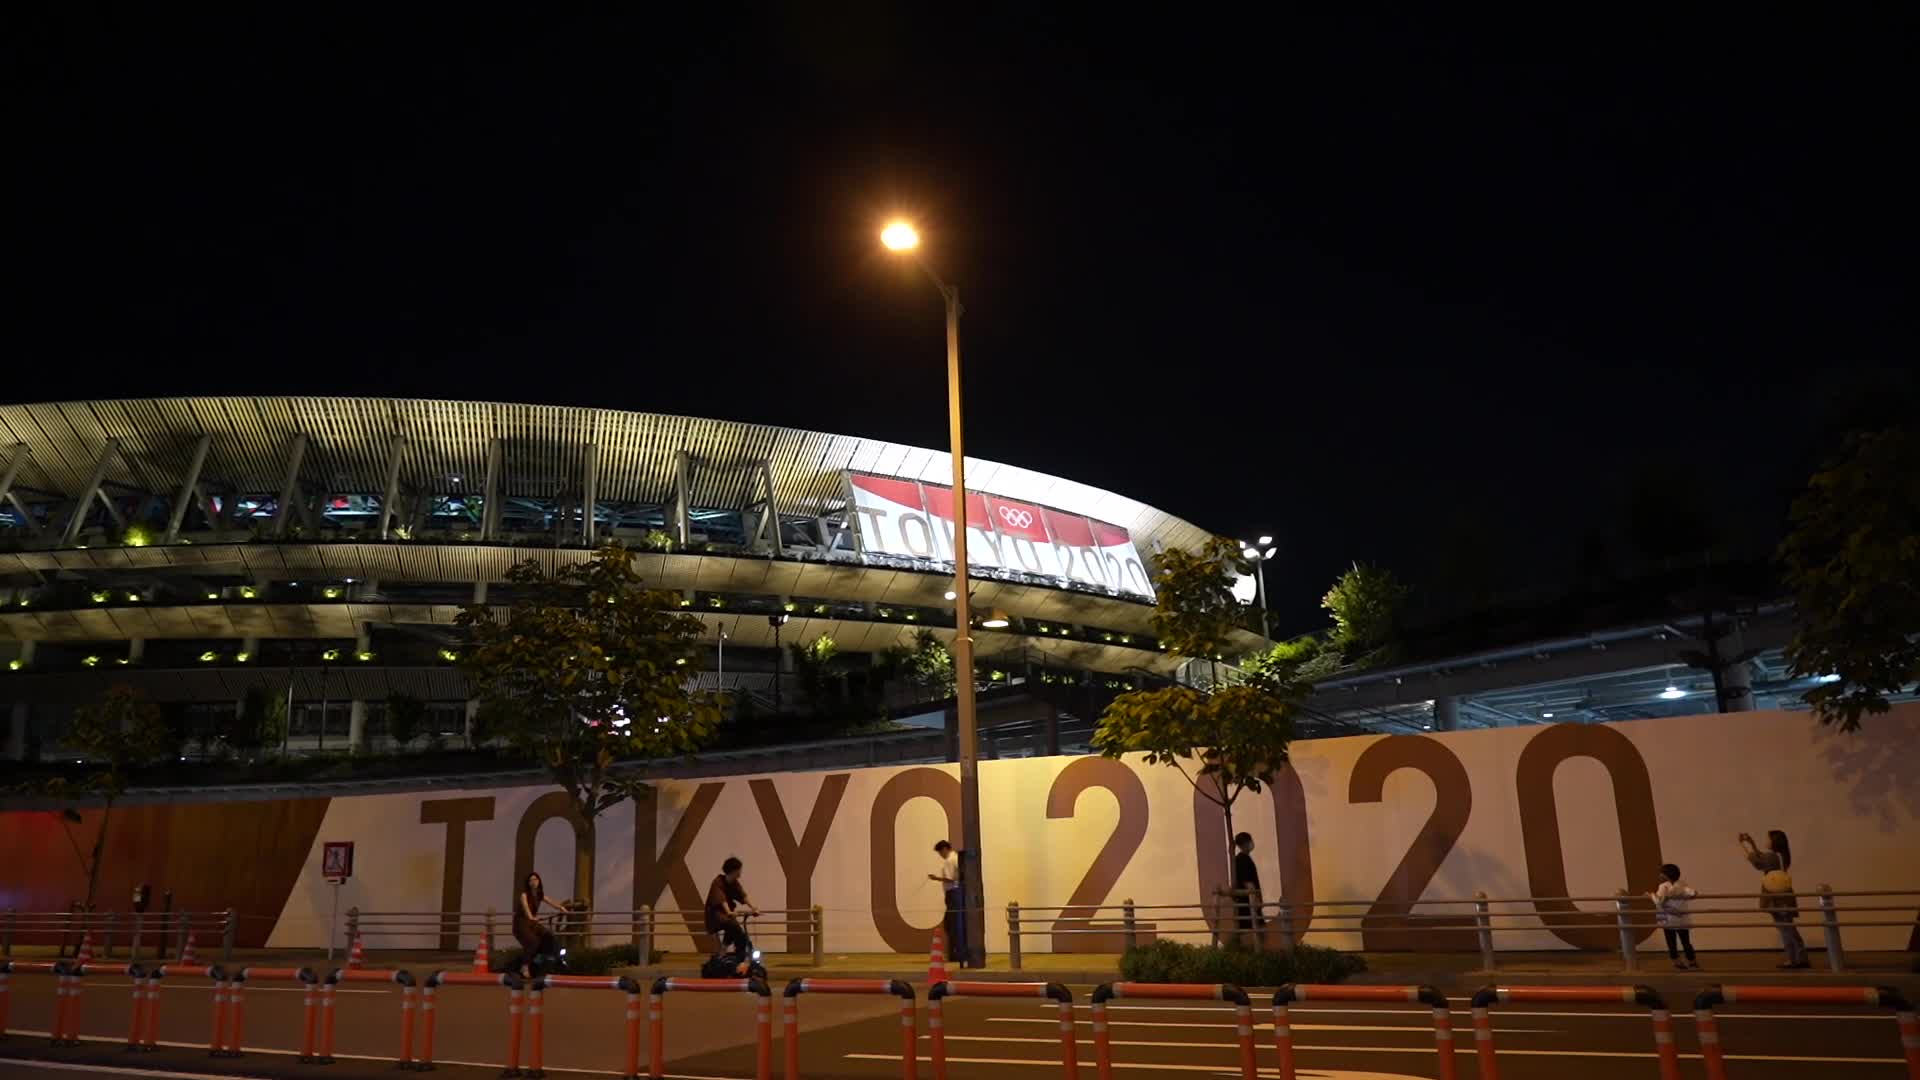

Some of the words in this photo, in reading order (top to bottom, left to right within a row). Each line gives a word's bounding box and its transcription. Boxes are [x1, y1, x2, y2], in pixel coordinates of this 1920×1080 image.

[1058, 546, 1154, 597] 2020
[420, 767, 966, 953] TOKYO
[1046, 722, 1663, 953] 2020
